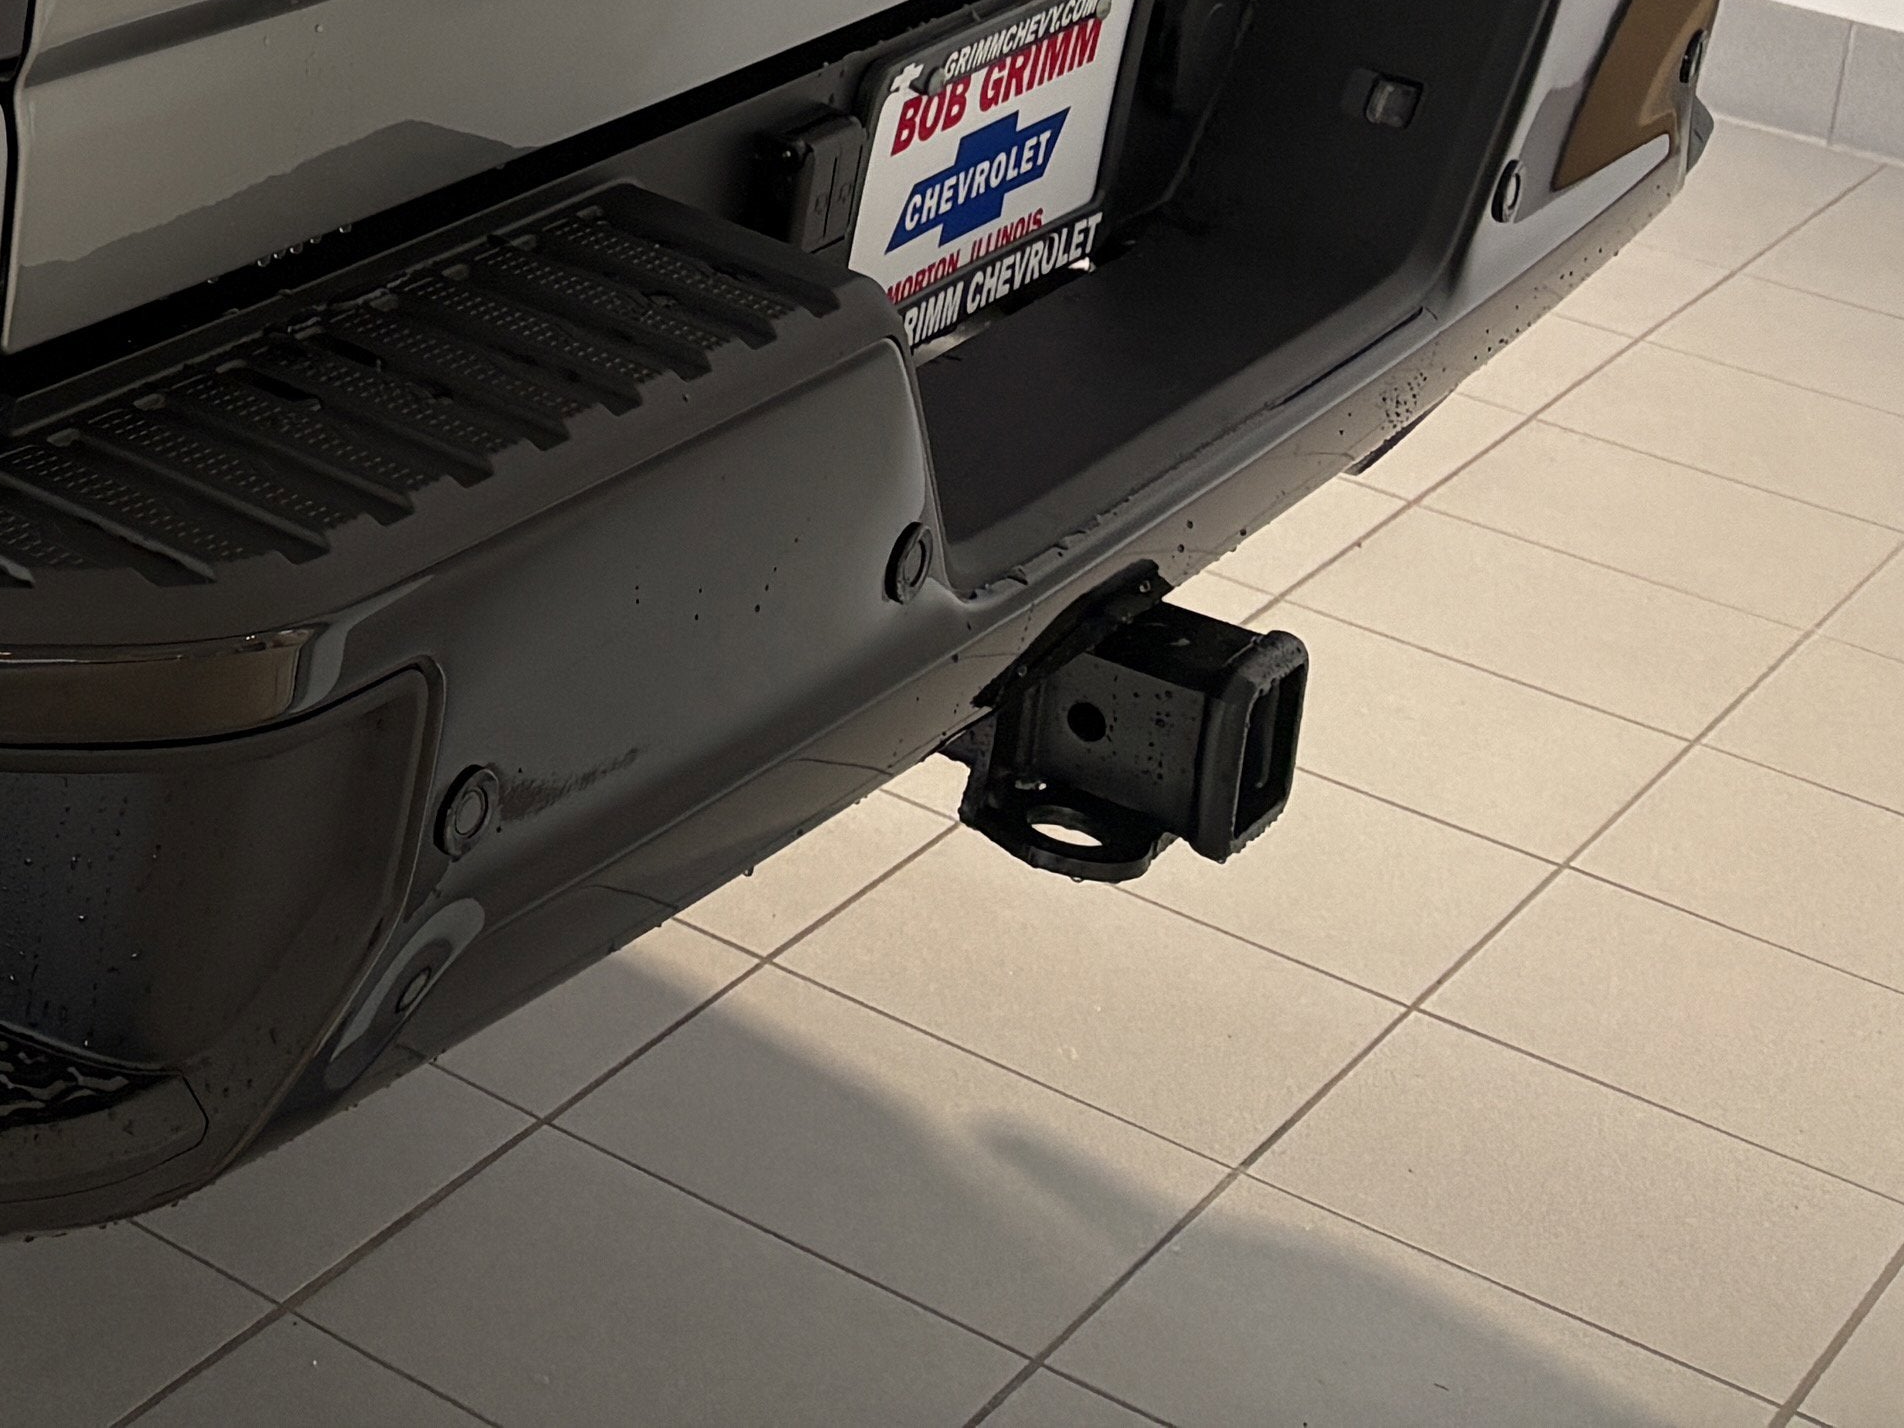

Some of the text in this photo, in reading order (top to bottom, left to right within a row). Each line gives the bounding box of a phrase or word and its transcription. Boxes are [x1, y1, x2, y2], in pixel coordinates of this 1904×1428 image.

[891, 16, 1103, 158] BOB GRIMM
[904, 129, 1053, 233] CHEVROLET
[903, 212, 1103, 350] RIMM CHEVROLET
